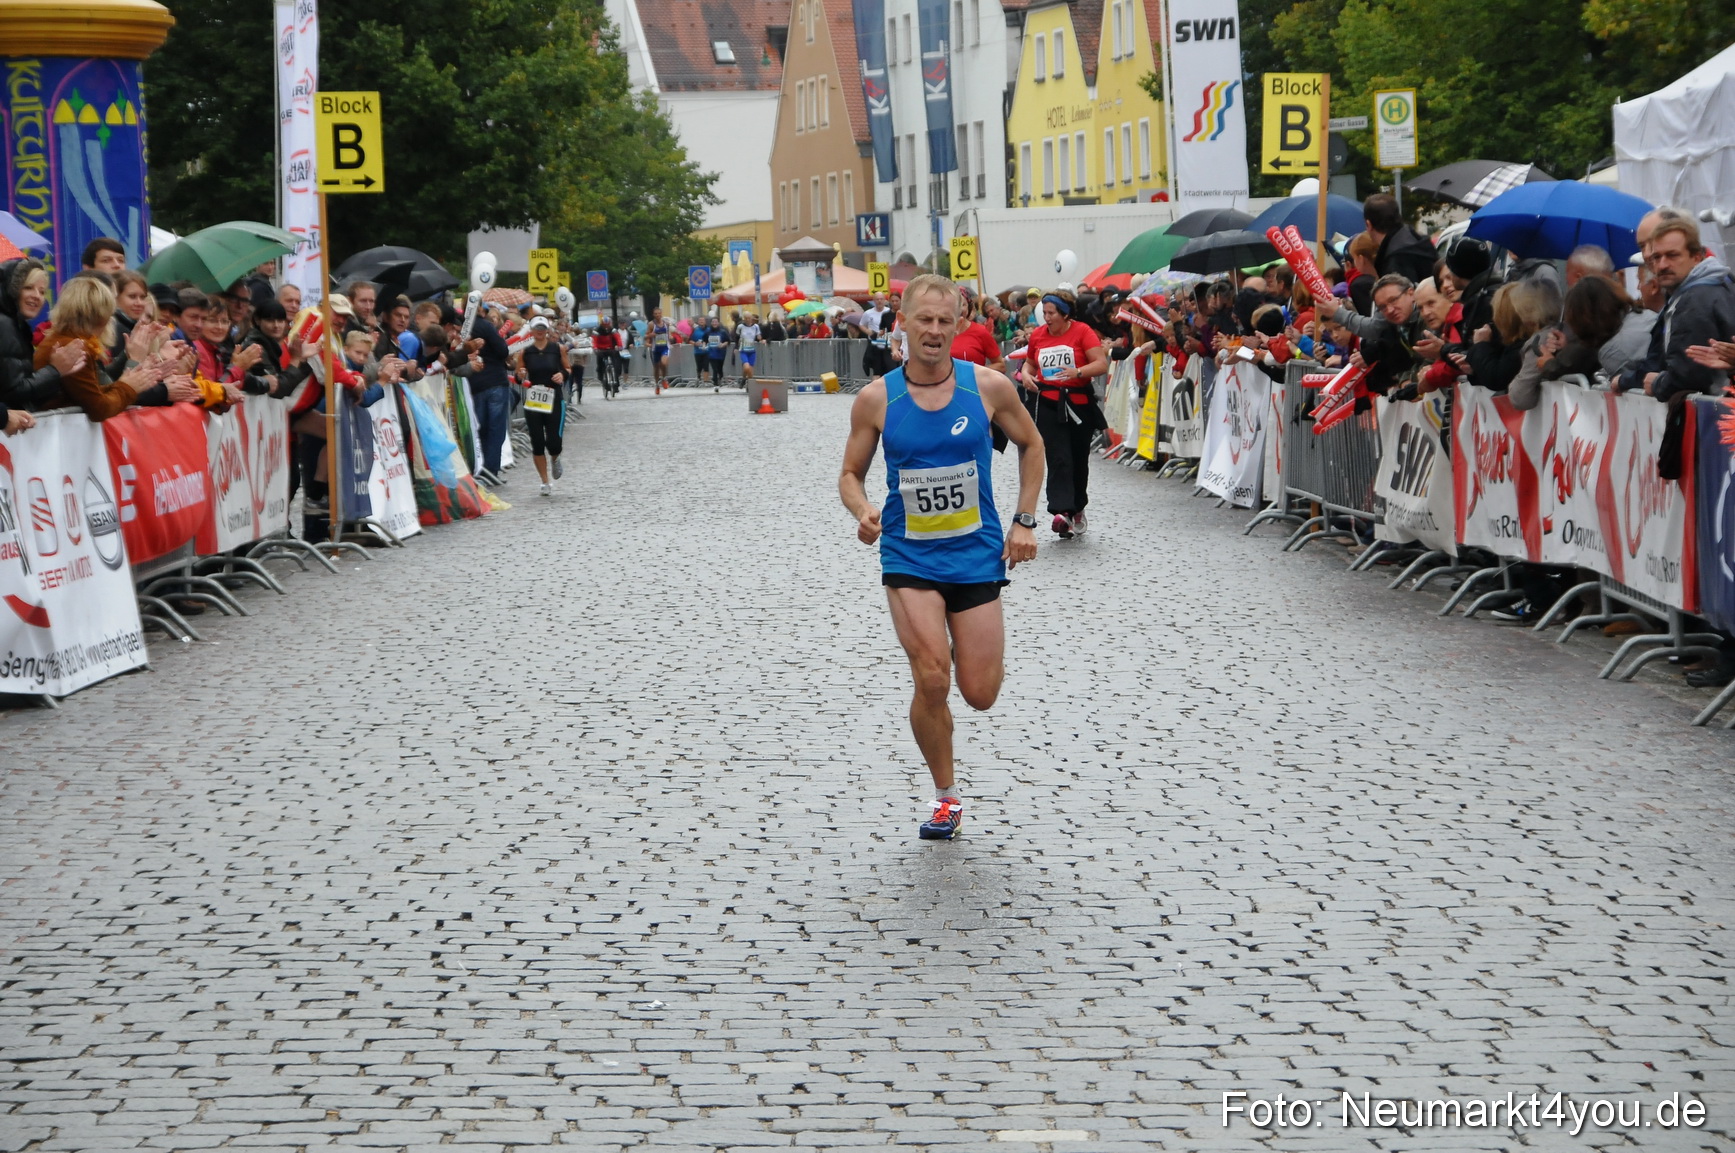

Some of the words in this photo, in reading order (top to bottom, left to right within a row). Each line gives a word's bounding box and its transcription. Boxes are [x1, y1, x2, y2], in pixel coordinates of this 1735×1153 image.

[1175, 17, 1236, 43] swn
[1272, 78, 1322, 95] Block
[321, 96, 373, 114] Block
[1047, 106, 1067, 129] HOTEL
[1280, 104, 1312, 151] B
[332, 123, 366, 170] B
[1184, 189, 1221, 197] stadtwerke
[952, 239, 976, 247] Block
[531, 251, 554, 259] Block
[957, 249, 972, 270] C
[535, 262, 551, 283] C
[873, 272, 885, 288] D
[591, 291, 607, 299] TAXI
[691, 288, 709, 297] TAXI
[1042, 353, 1072, 368] 2276
[530, 391, 548, 403] 310
[901, 476, 925, 484] PARTL
[926, 472, 965, 484] Neumarkt
[916, 483, 965, 513] 555
